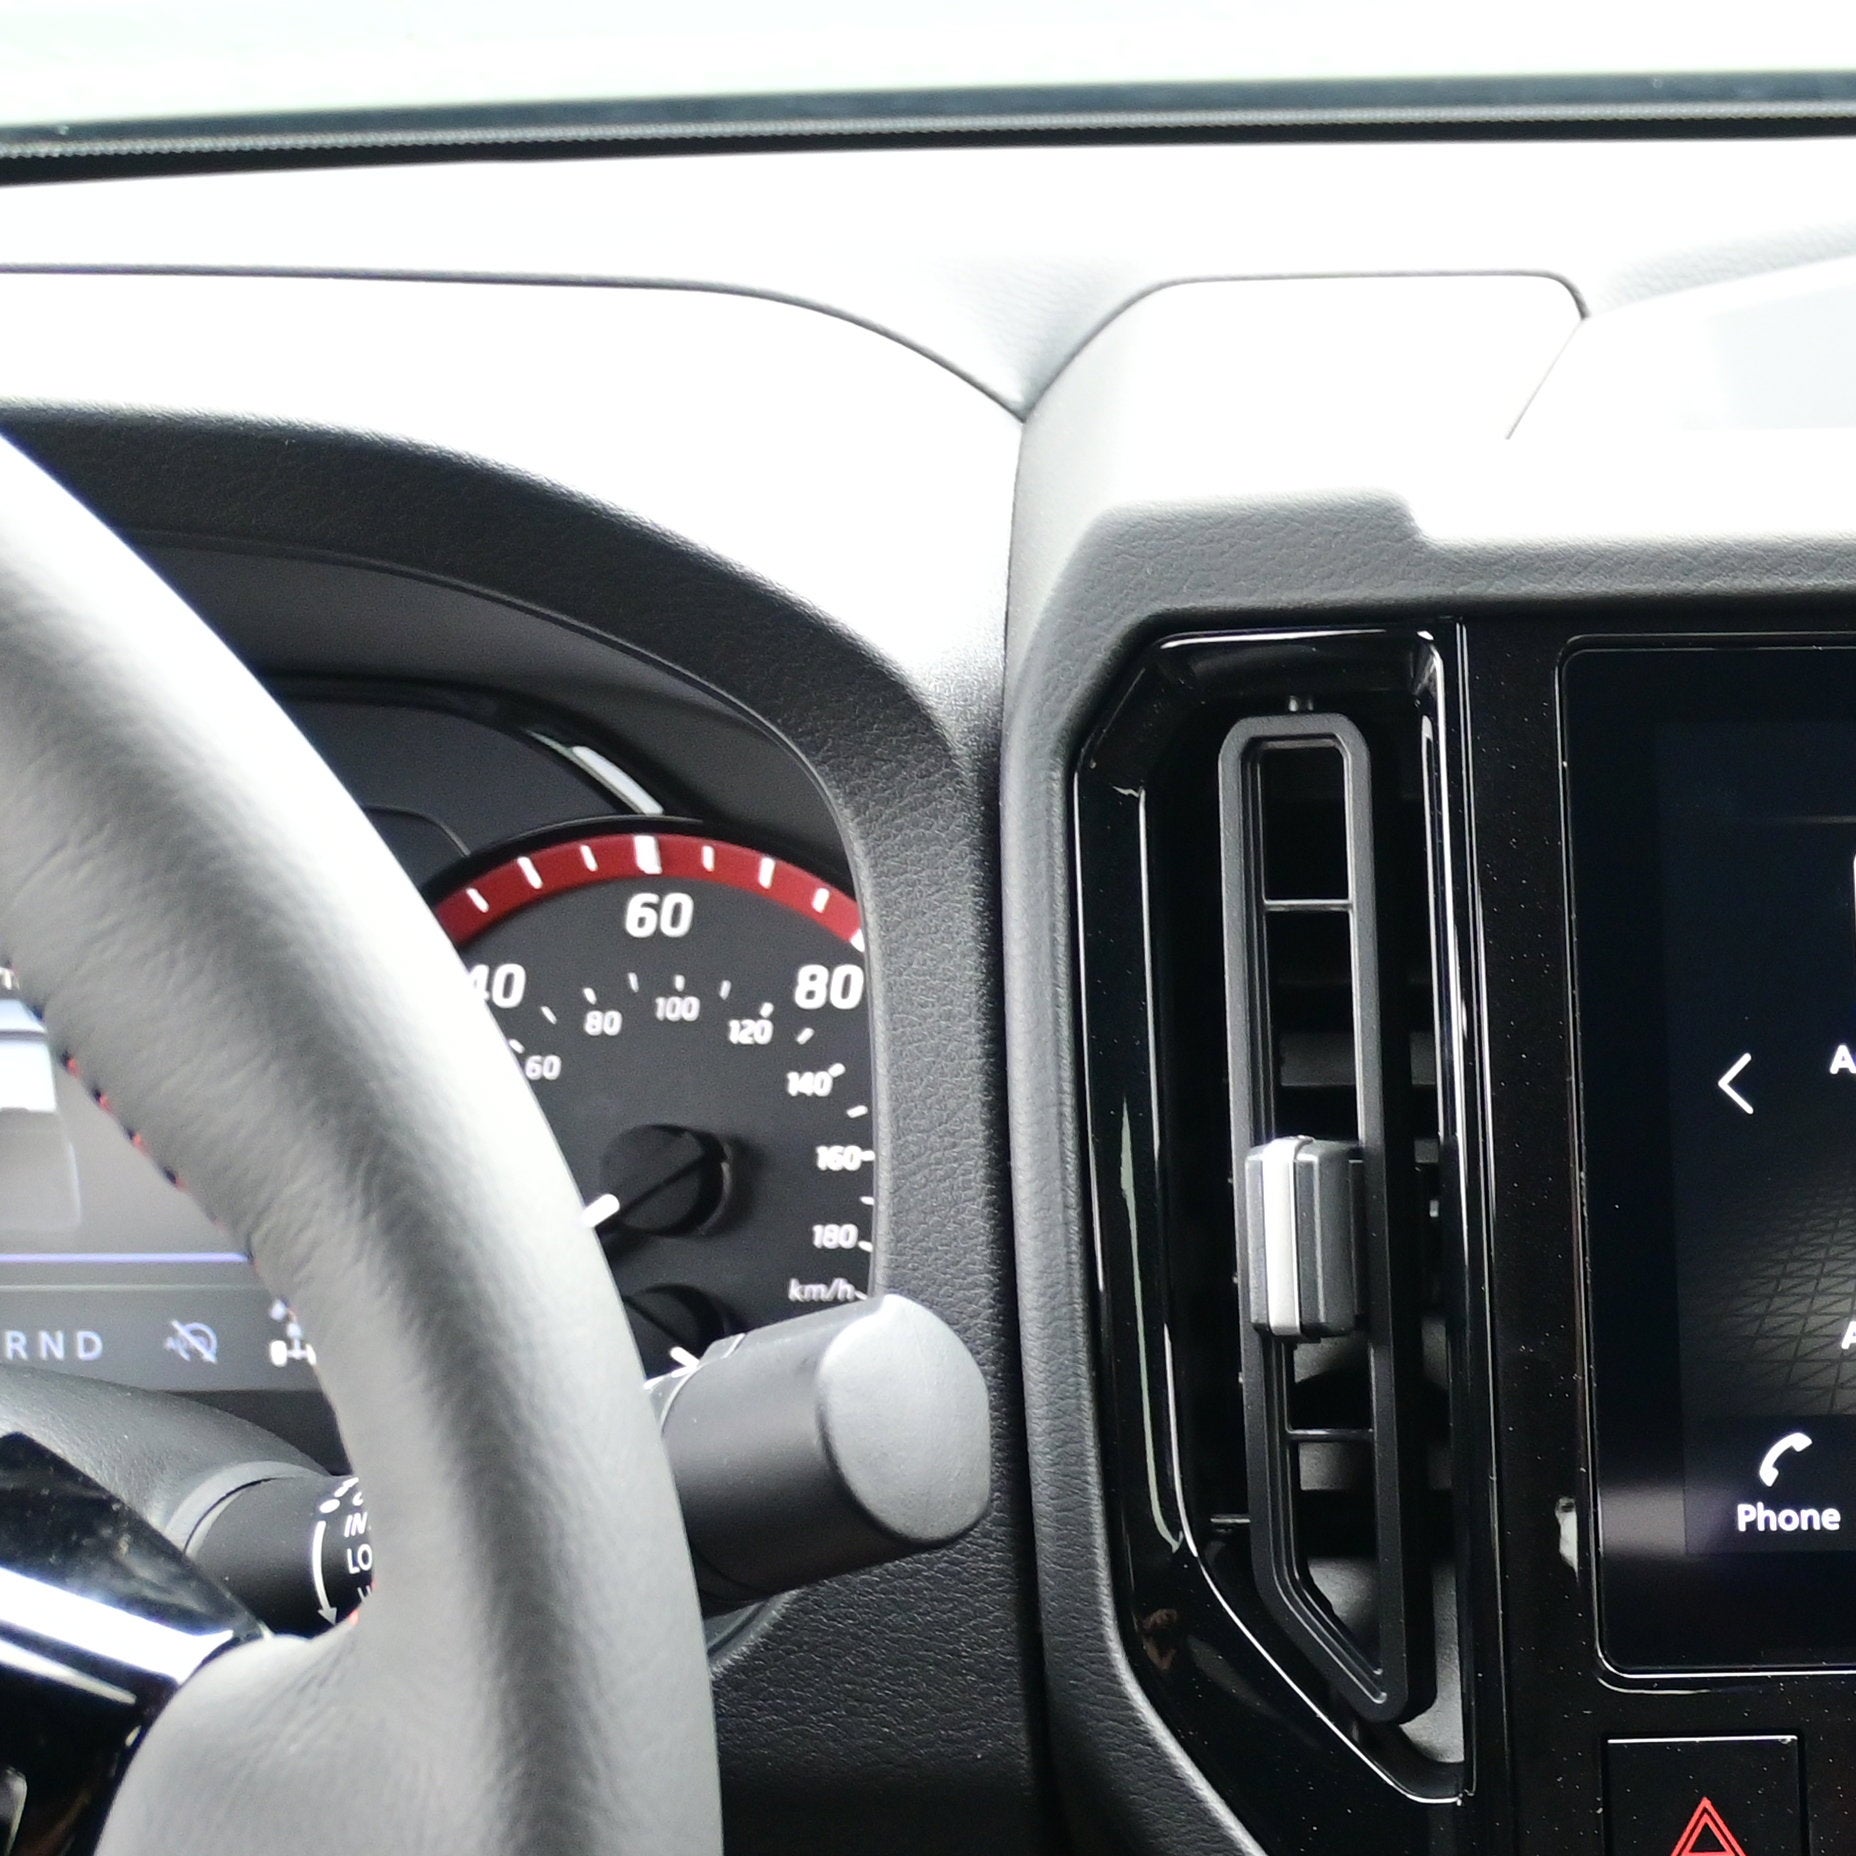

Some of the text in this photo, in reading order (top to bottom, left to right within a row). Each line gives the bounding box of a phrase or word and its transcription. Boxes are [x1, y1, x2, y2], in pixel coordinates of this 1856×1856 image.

[625, 892, 694, 938] 60
[794, 964, 864, 1010] 80
[655, 996, 700, 1021] 100
[583, 1010, 622, 1036] 80
[728, 1018, 773, 1046] 120
[524, 1054, 561, 1081] 60
[786, 1071, 832, 1097] 140
[815, 1145, 861, 1171] 160
[812, 1223, 858, 1250] 180
[788, 1277, 855, 1302] km/h
[39, 1331, 65, 1361] N
[76, 1330, 103, 1361] D
[344, 1510, 371, 1538] IN
[1737, 1502, 1841, 1532] Phone
